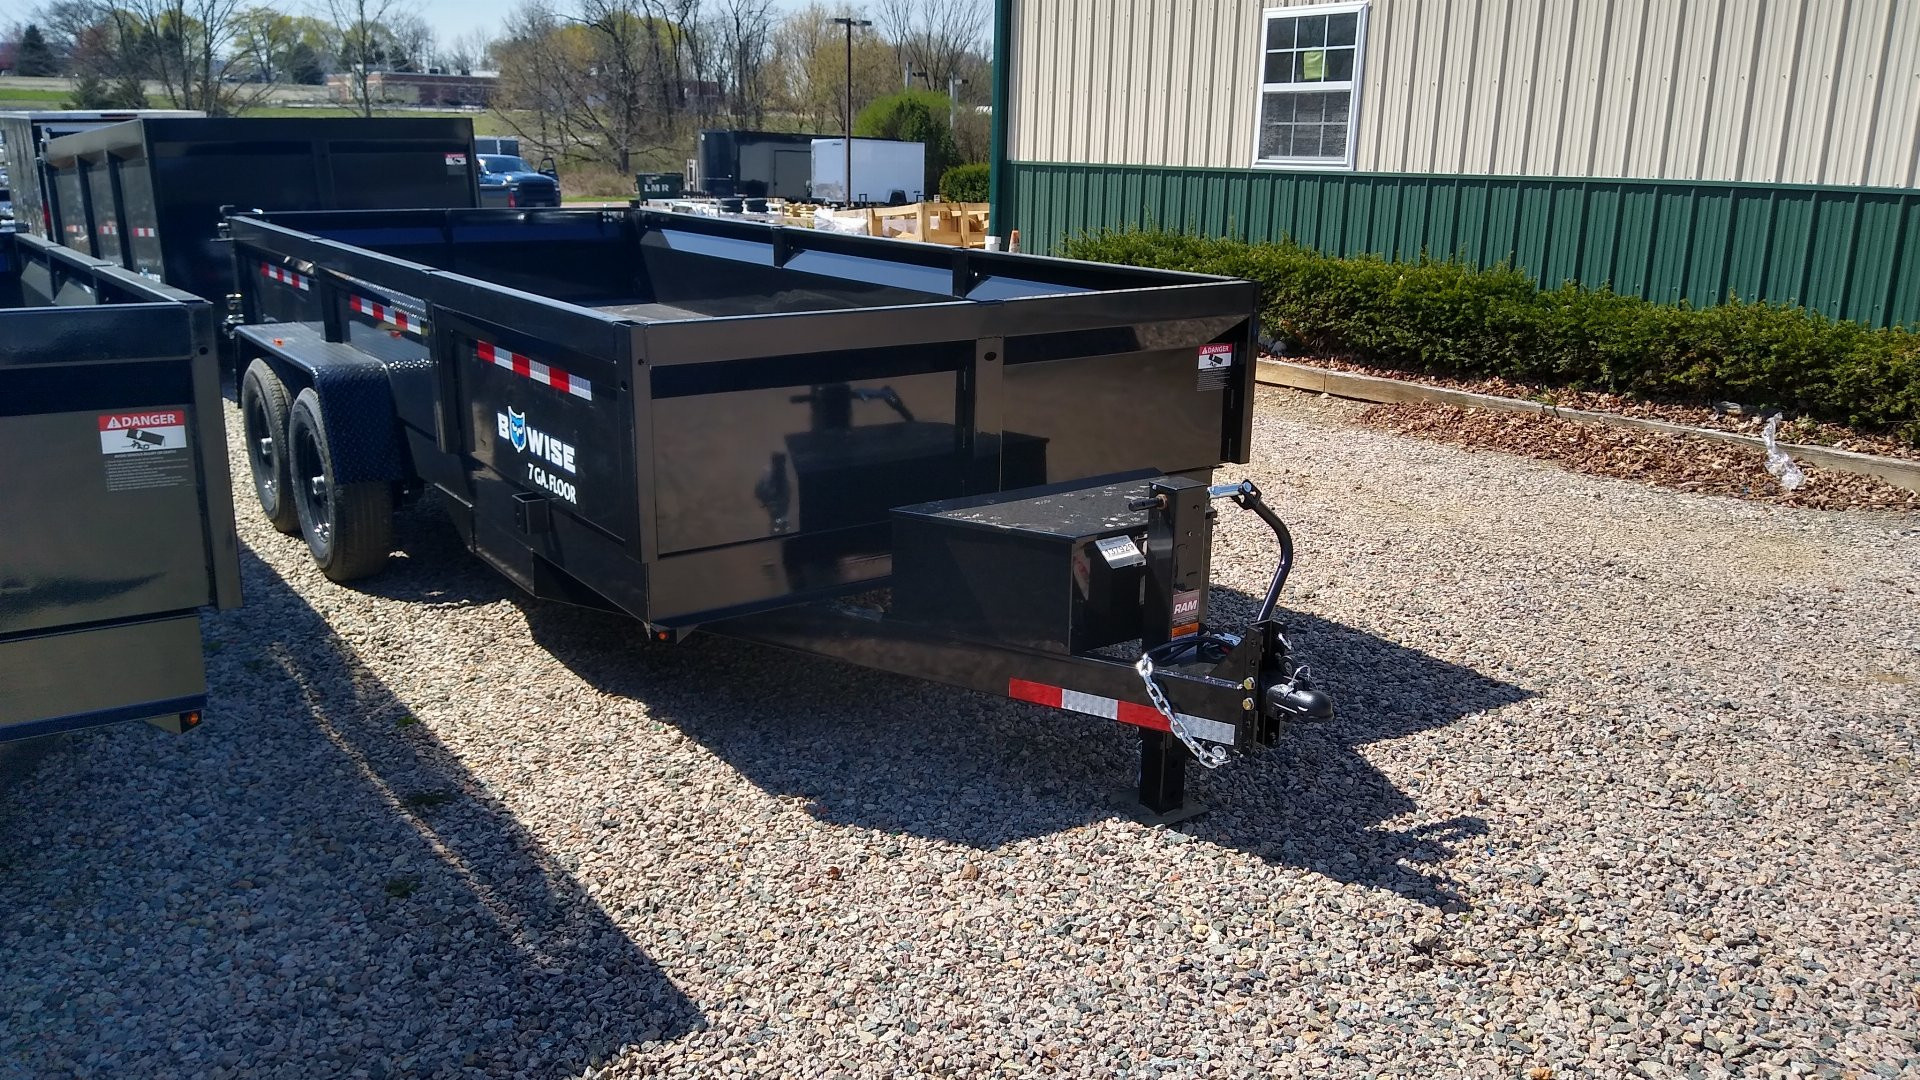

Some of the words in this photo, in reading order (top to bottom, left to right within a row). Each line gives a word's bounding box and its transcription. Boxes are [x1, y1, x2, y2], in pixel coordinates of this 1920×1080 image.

[644, 184, 669, 192] LMR
[121, 414, 176, 427] DANGER
[528, 462, 534, 480] 7
[549, 474, 577, 504] FLOOR
[1174, 600, 1198, 614] RAM
